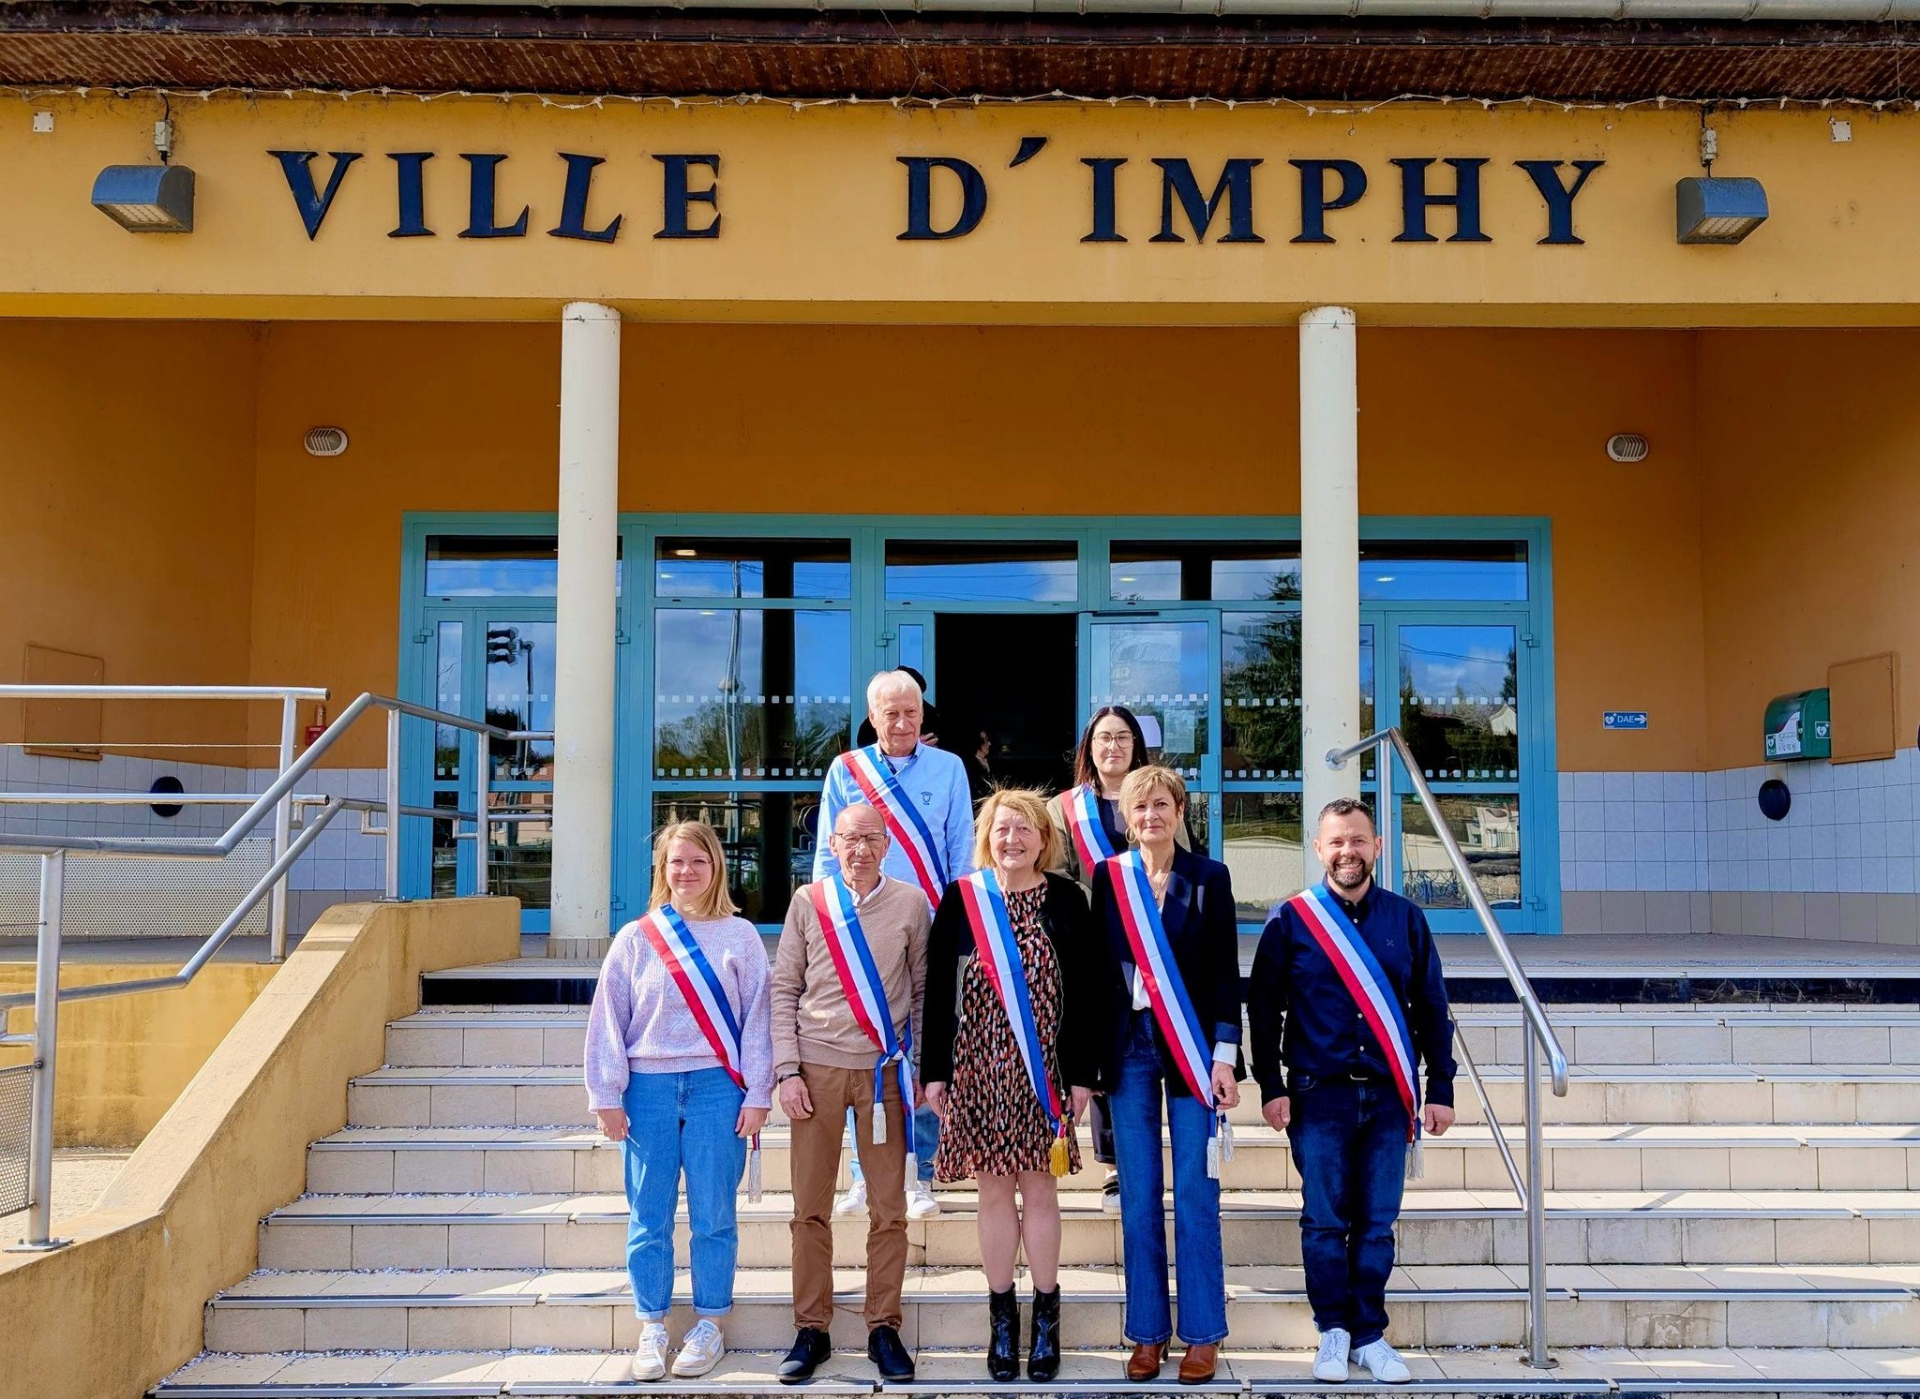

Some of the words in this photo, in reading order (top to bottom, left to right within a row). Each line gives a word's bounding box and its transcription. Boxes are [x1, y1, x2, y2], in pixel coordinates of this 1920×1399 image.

[266, 149, 721, 244] VILLE
[896, 136, 1607, 245] D'IMPHY
[1617, 715, 1635, 723] DAE
